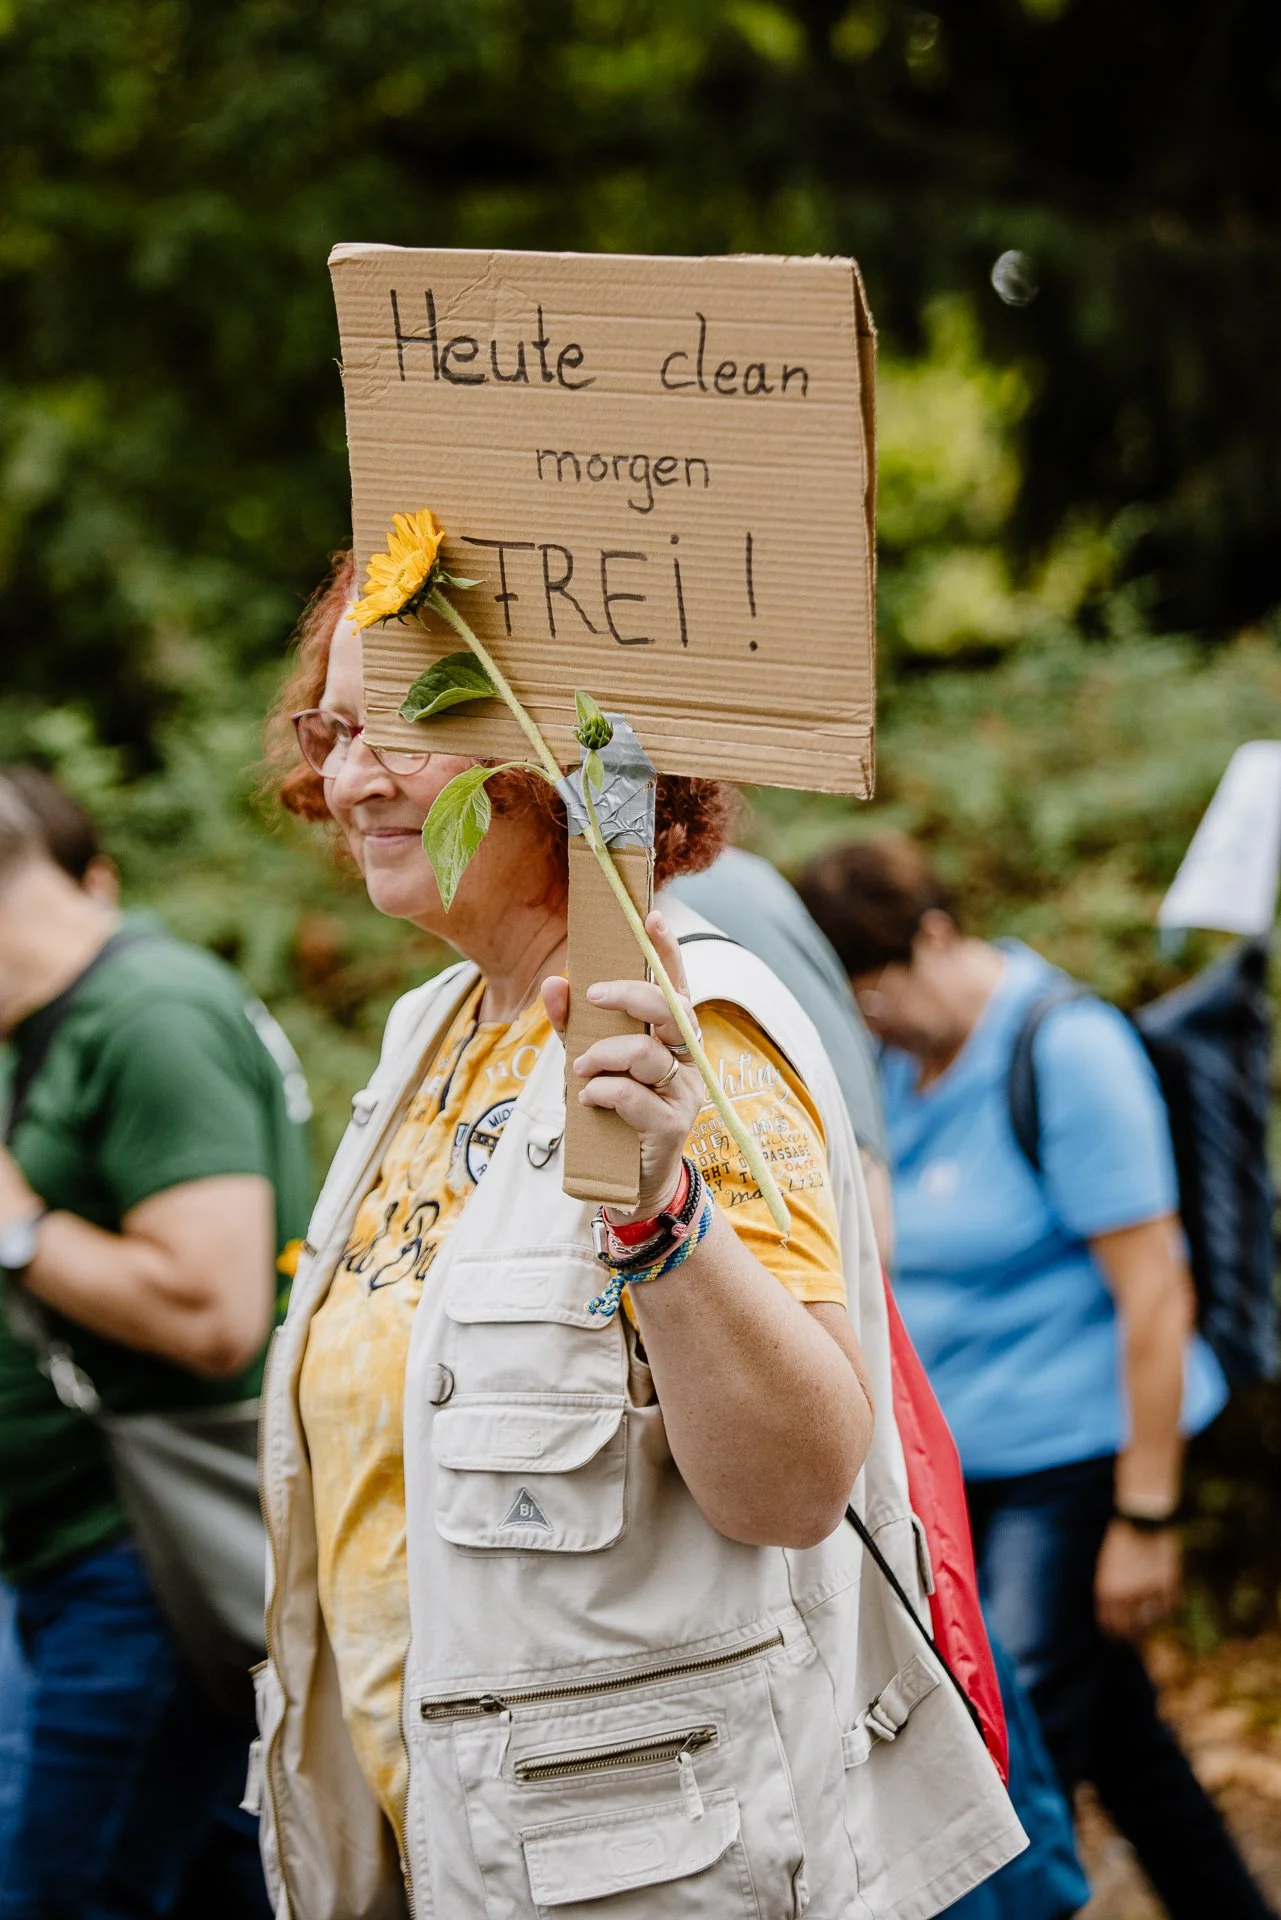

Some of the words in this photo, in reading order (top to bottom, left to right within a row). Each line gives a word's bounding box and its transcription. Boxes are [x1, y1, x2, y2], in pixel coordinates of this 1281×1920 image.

[389, 287, 597, 391] Heute
[660, 311, 809, 397] clean
[536, 447, 710, 514] morgen
